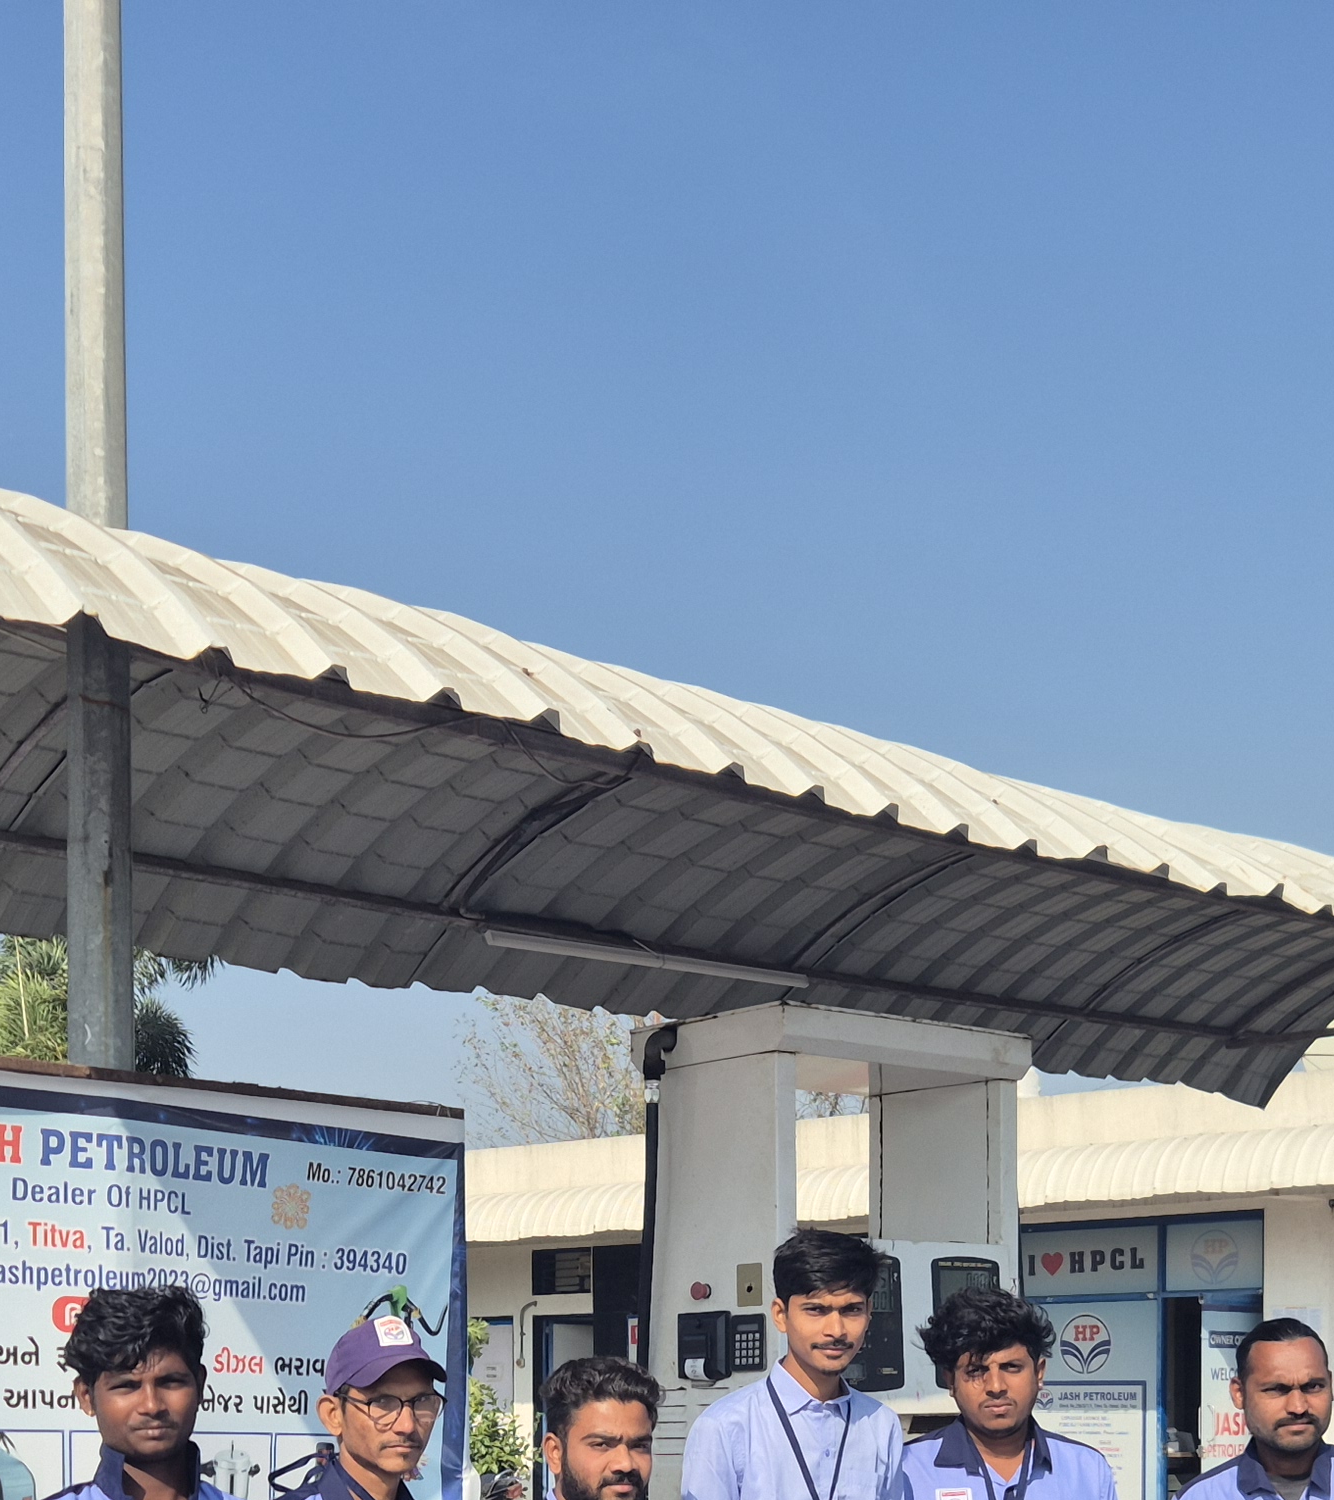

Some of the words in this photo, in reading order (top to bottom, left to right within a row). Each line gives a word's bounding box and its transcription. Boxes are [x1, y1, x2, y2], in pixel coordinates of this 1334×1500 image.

[40, 1128, 270, 1189] PETROLEUM
[307, 1161, 341, 1184] Mo.:
[347, 1166, 447, 1195] 7861042742
[11, 1176, 97, 1206] Dealer
[106, 1183, 131, 1209] Of
[138, 1187, 192, 1216] HPCL
[28, 1221, 93, 1254] Titva,
[101, 1225, 130, 1252] Ta.
[137, 1228, 190, 1261] Valod,
[196, 1234, 236, 1262] Dist.
[244, 1238, 281, 1270] Tapi
[287, 1242, 315, 1269] Pin
[334, 1247, 407, 1276] 394340
[1028, 1255, 1036, 1276] I
[1069, 1247, 1145, 1274] HPCL
[1073, 1324, 1100, 1341] HP
[1211, 1367, 1238, 1381] WELC
[200, 1383, 243, 1414] નેજર
[253, 1386, 309, 1416] પાસેથી
[1058, 1392, 1080, 1401] JASH
[1083, 1392, 1137, 1401] PETROLEUM
